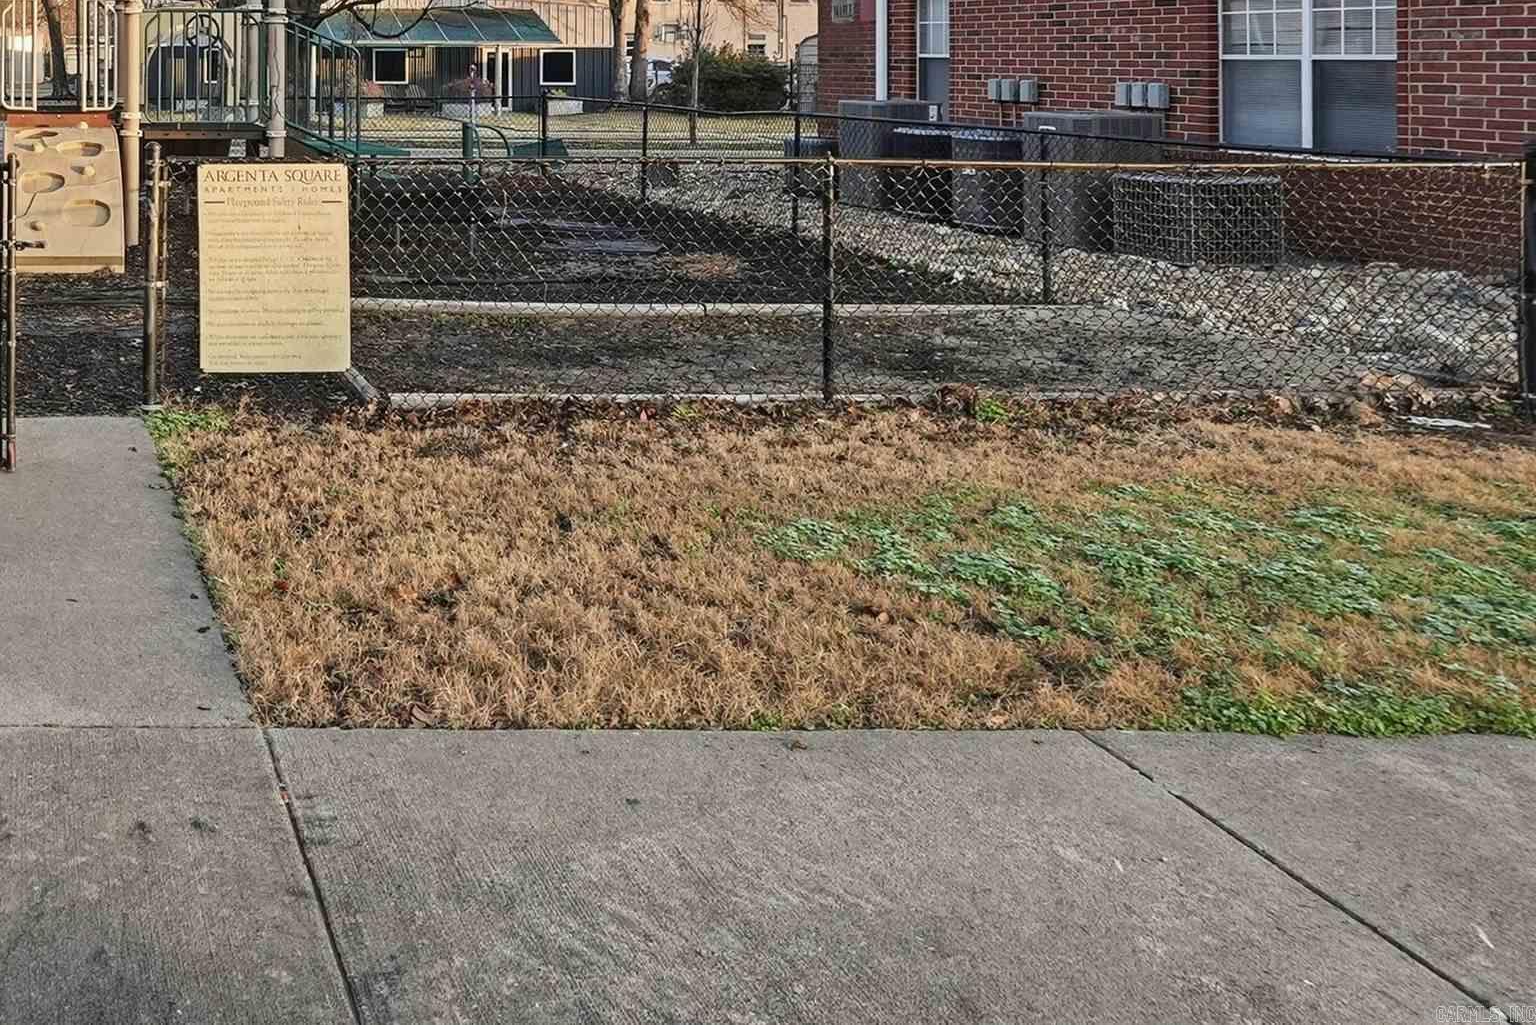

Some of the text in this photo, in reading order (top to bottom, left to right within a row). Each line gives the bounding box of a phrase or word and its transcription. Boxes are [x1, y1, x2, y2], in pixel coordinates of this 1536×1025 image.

[204, 169, 342, 185] ARGENTA SQUARE
[204, 185, 343, 194] APARTMENTS HOMES
